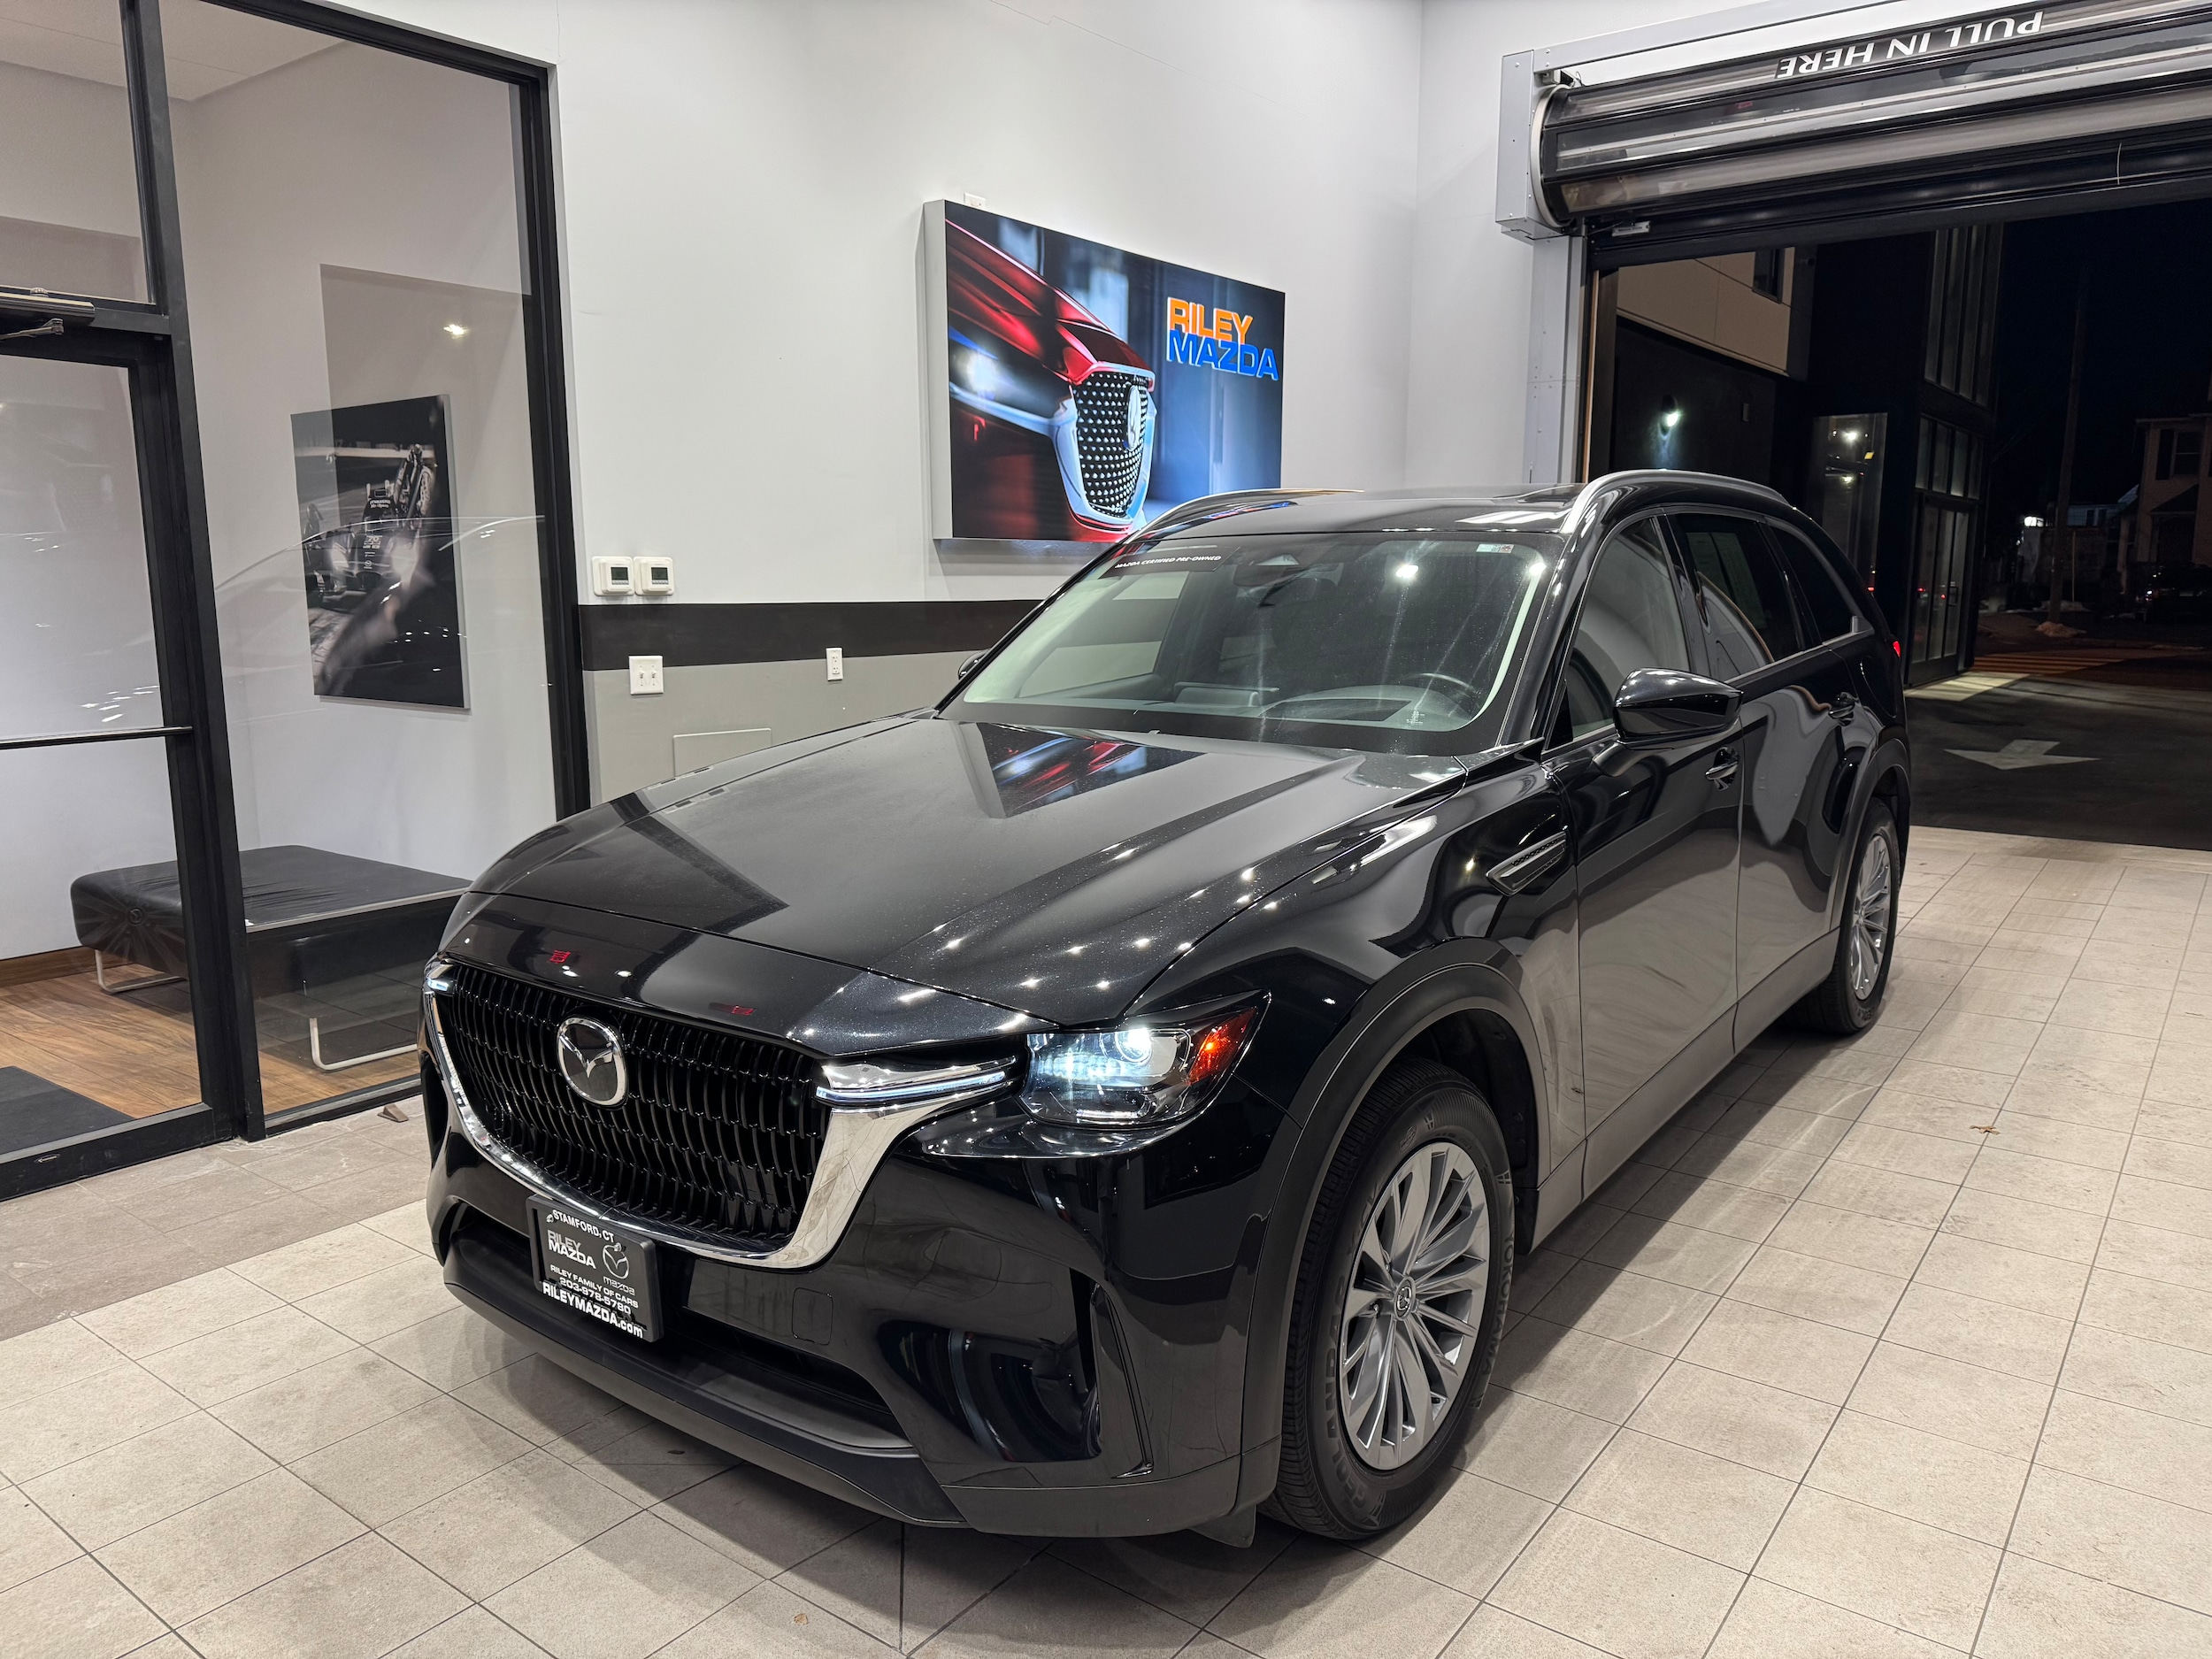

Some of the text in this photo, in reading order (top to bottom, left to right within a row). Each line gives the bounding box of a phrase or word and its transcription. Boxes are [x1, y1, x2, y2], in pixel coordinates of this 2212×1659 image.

[1777, 12, 2043, 79] PULL IN HERE
[1167, 296, 1253, 344] RILEY
[1166, 328, 1279, 380] MAZDA
[548, 1229, 581, 1251] RILEY
[552, 1210, 615, 1243] STAMFORD, CT
[548, 1239, 596, 1269] MAZDA
[550, 1264, 572, 1279] RILEY
[573, 1274, 602, 1291] FAMILY
[615, 1293, 639, 1309] CARS
[559, 1277, 631, 1315] 203-978-5780
[1482, 1231, 1515, 1375] YOKOHAMA
[542, 1281, 643, 1339] RILEYMAZDA.com
